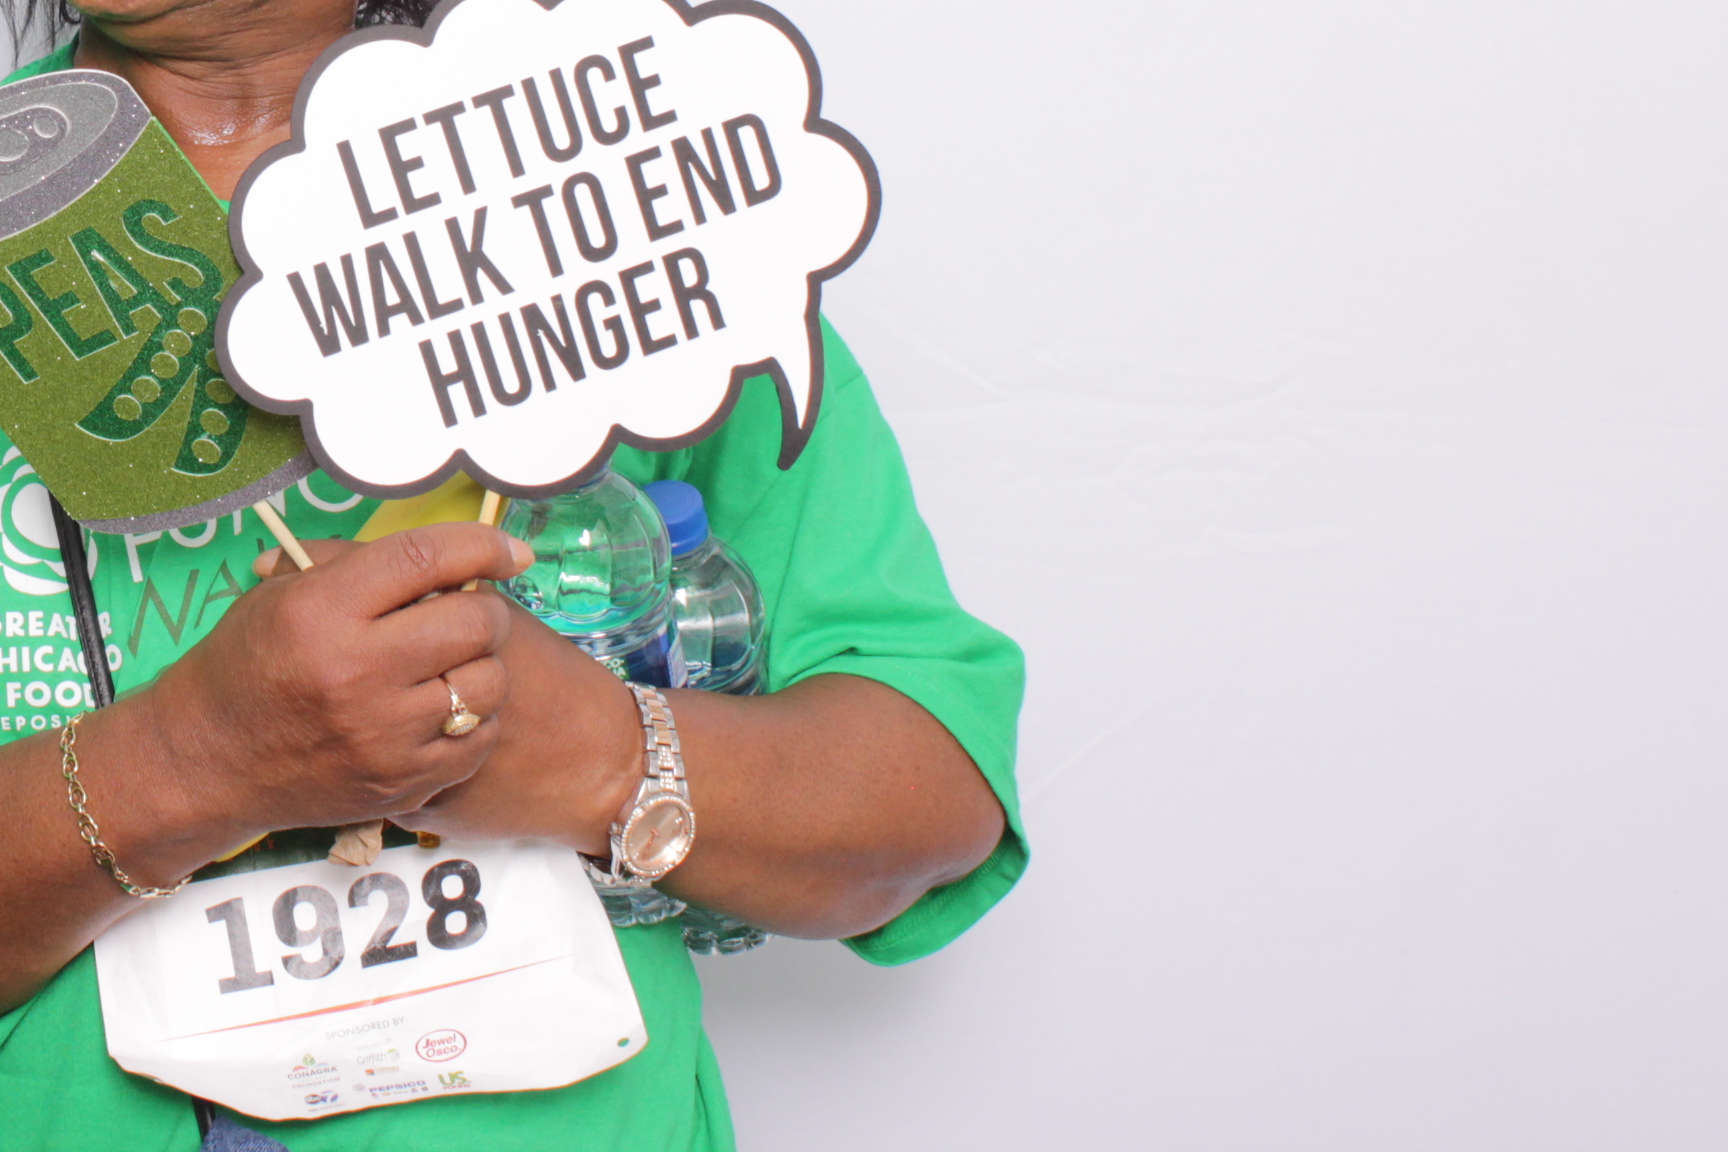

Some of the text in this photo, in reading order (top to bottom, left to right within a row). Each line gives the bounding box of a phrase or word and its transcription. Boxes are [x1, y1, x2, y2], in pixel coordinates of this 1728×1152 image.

[336, 35, 679, 231] LETTUCE
[285, 113, 782, 358] WALK TO END
[418, 247, 727, 429] HUNGER
[204, 858, 488, 995] 1928
[325, 1016, 408, 1041] SPONSORED BY:
[422, 1033, 457, 1049] Jewel
[357, 1051, 387, 1065] Griffith
[426, 1044, 459, 1058] Osco
[287, 1066, 338, 1080] CONAGRA
[292, 1076, 341, 1089] FOUNDATION
[369, 1080, 426, 1093] PEPSICO
